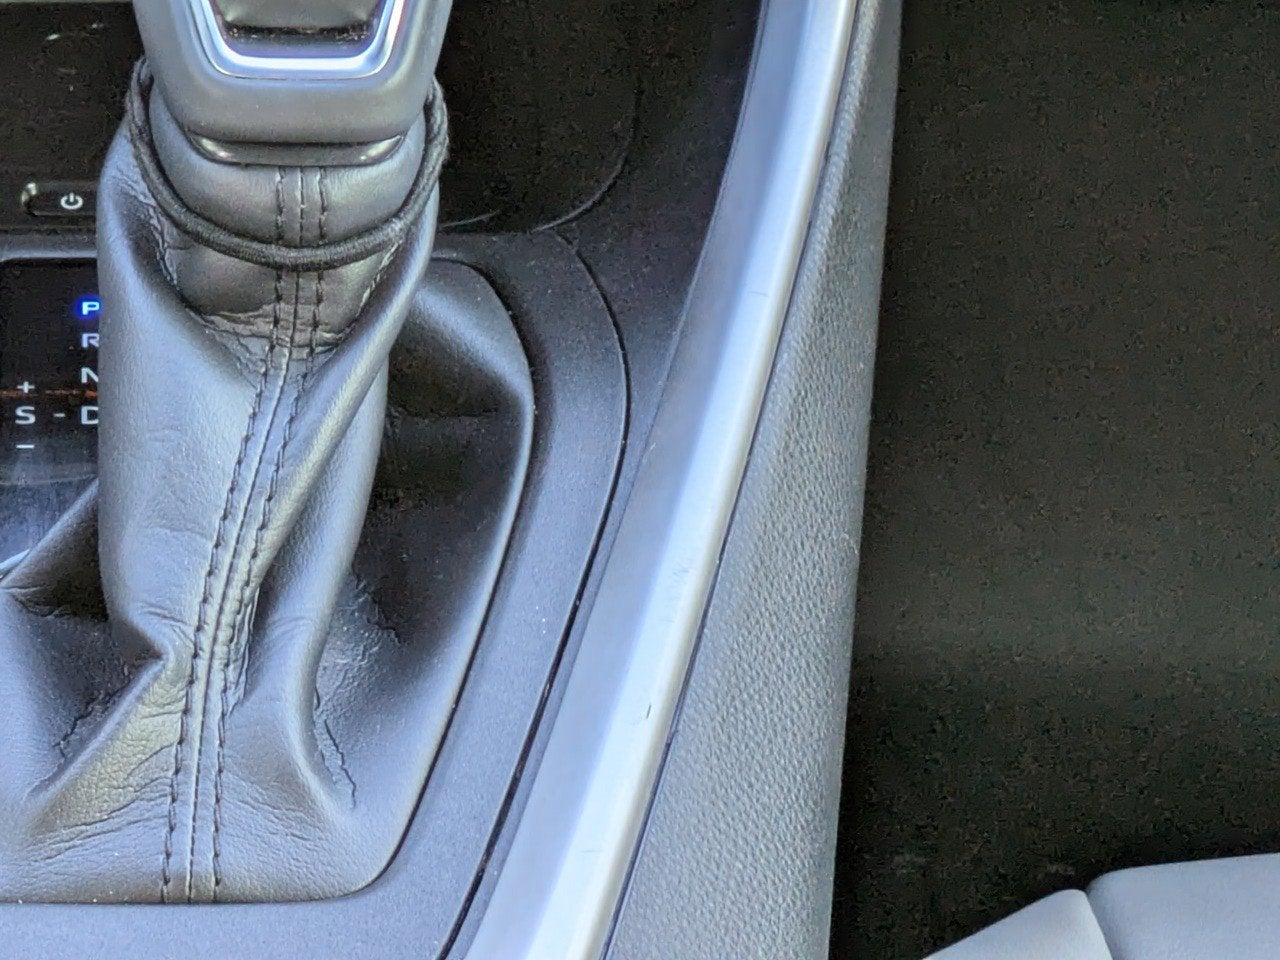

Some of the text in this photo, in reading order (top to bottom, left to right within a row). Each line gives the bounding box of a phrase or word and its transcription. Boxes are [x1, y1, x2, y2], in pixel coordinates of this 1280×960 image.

[81, 301, 100, 316] P
[81, 333, 100, 349] R
[80, 367, 100, 384] N
[15, 406, 37, 426] S
